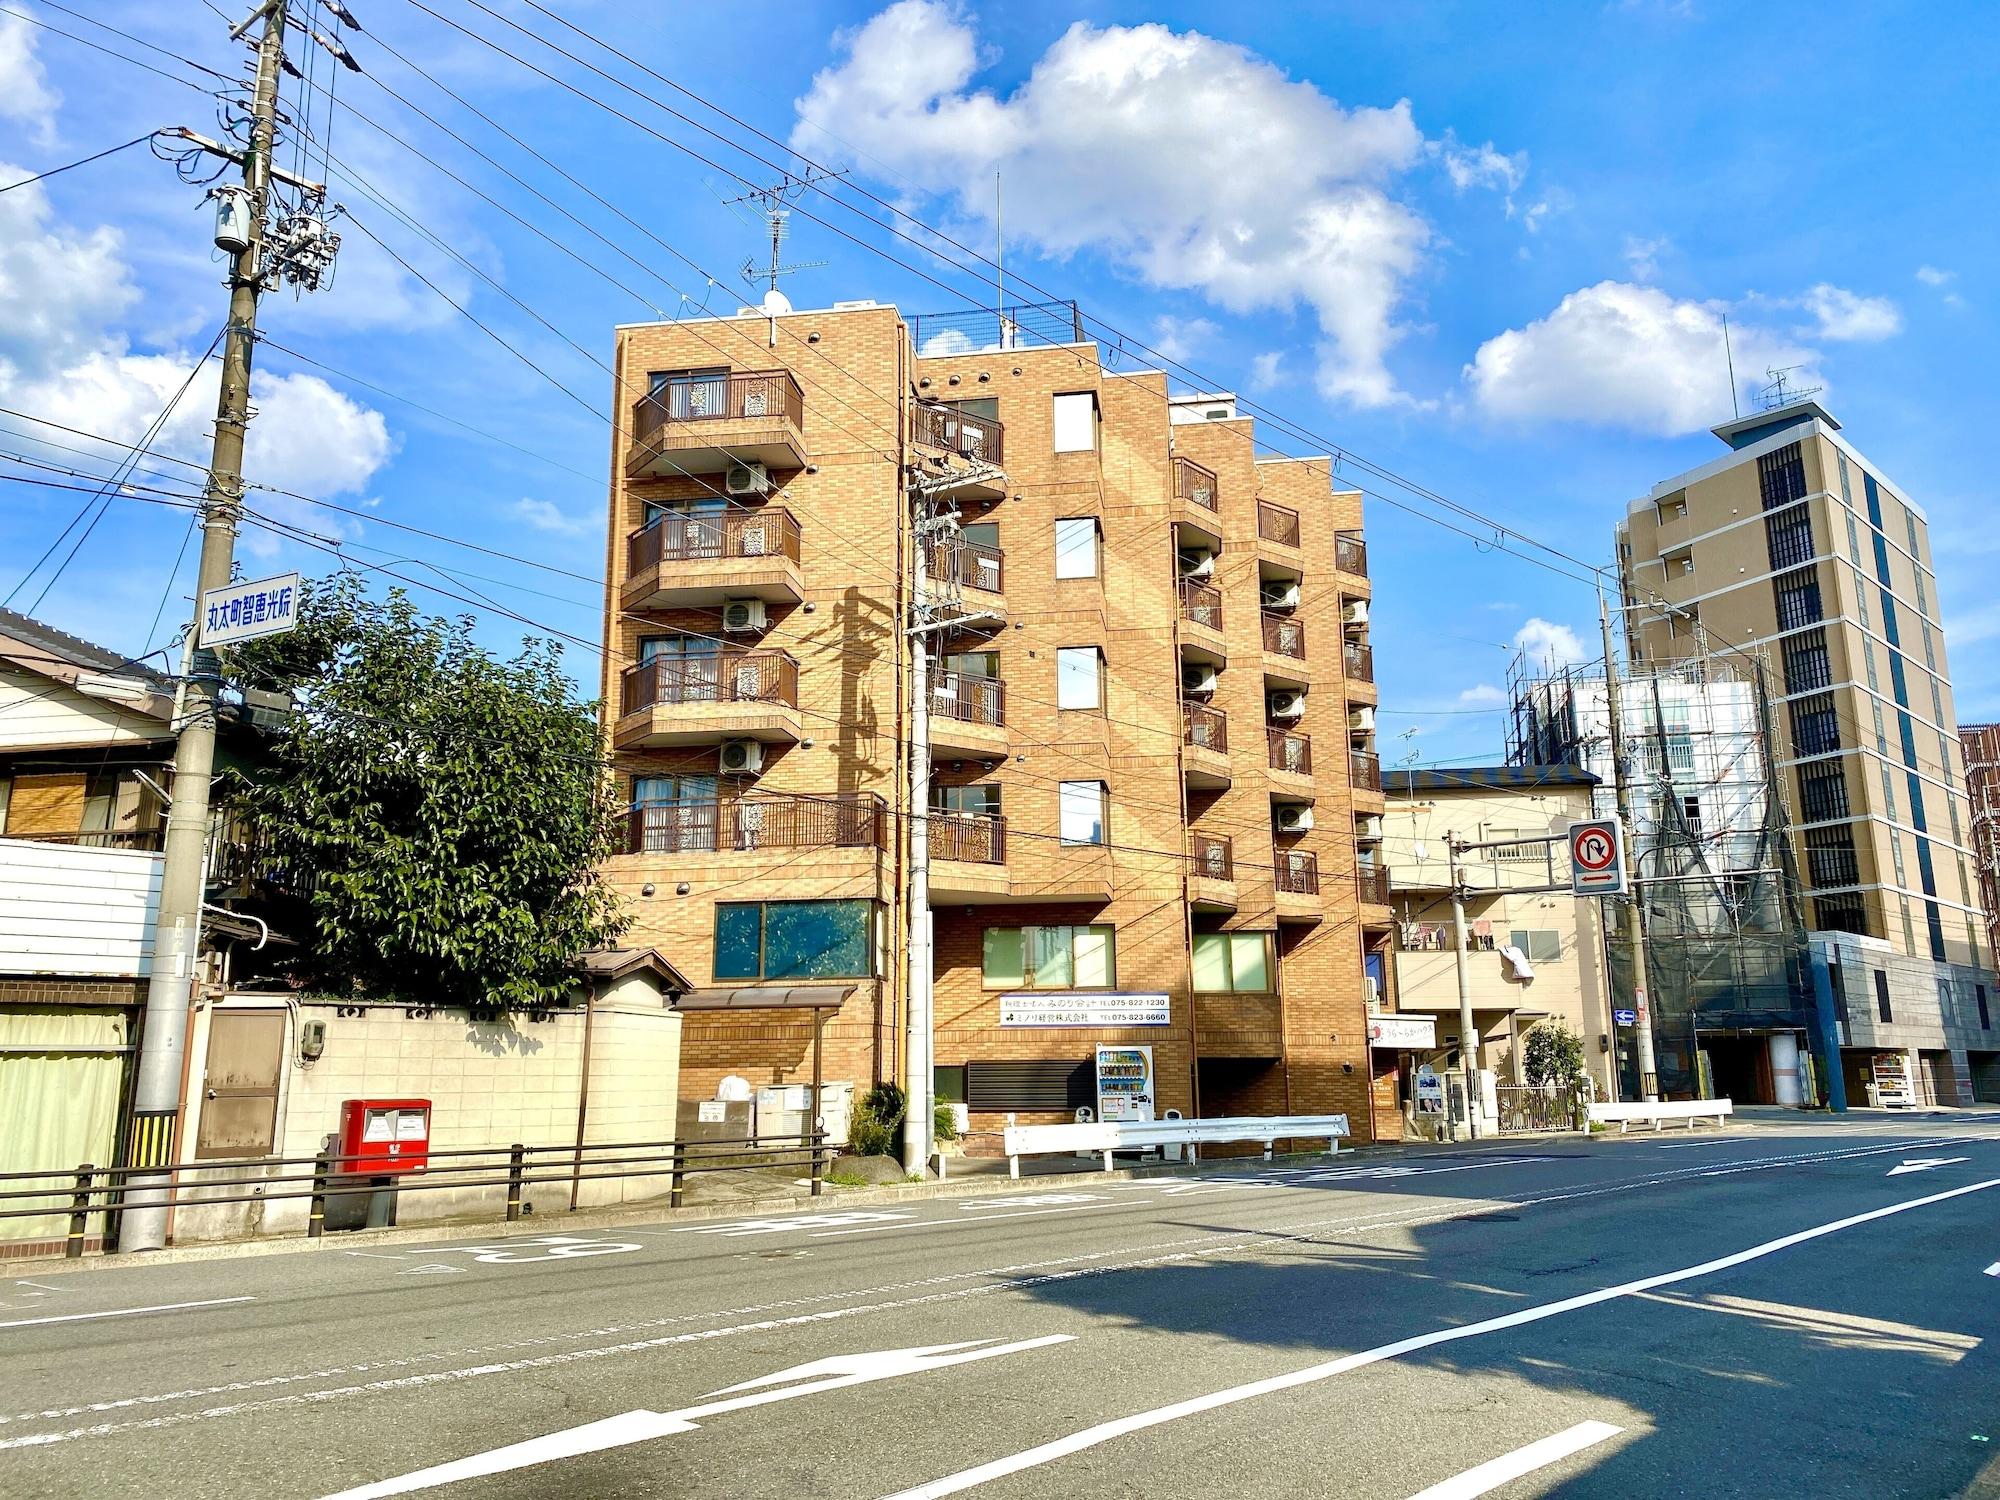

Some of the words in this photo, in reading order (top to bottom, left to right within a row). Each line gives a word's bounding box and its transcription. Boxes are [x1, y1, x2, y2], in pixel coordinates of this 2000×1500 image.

[206, 586, 293, 633] 丸太町智恵光院
[1016, 1013, 1089, 1023] ミノリ経営株式会社
